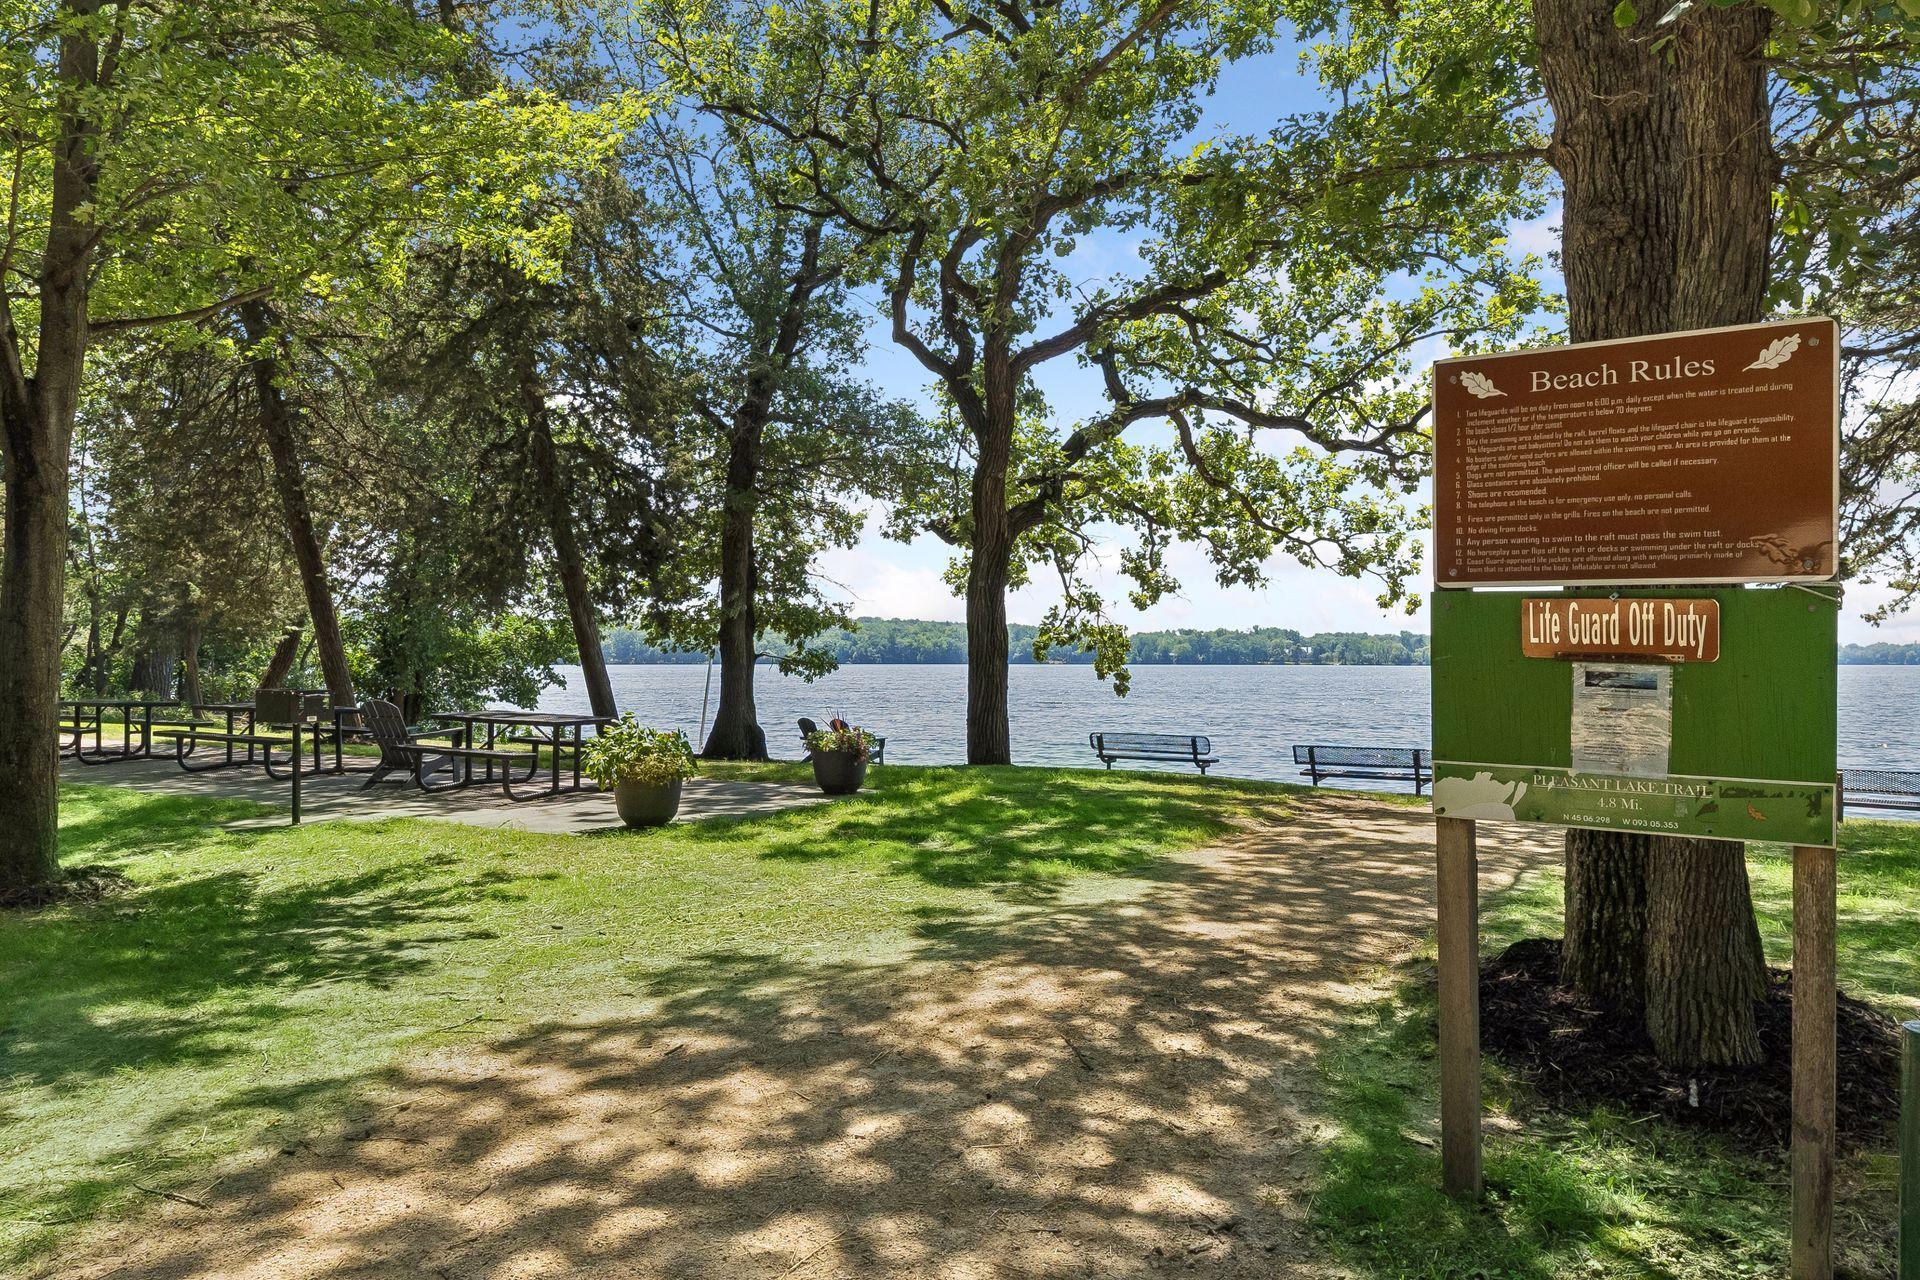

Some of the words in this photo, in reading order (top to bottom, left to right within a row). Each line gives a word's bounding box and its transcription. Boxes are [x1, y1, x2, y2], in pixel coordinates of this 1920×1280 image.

[1530, 364, 1619, 392] Beach
[1629, 356, 1716, 382] Rules
[1728, 385, 1754, 394] treated
[1548, 411, 1587, 420] temperature
[1626, 406, 1652, 414] degrees
[1651, 422, 1679, 431] lifeguard
[1718, 417, 1747, 426] lifeguard
[1528, 440, 1563, 450] babysitters!
[1570, 448, 1592, 456] allowed
[1710, 438, 1739, 447] provided
[1467, 472, 1482, 480] Dogs
[1578, 464, 1602, 473] control
[1485, 479, 1519, 487] containers
[1478, 500, 1508, 508] telephone
[1567, 496, 1602, 504] emergency
[1644, 491, 1674, 500] personal
[1510, 536, 1540, 544] wanting
[1477, 548, 1510, 556] horseplay
[1529, 602, 1560, 644] Life
[1568, 602, 1619, 646] Guard
[1629, 601, 1654, 646] Off
[1664, 604, 1706, 657] Duty
[1533, 775, 1612, 789] PLEASANT
[1616, 781, 1659, 793] LAKE
[1662, 783, 1709, 796] TRAIL
[1598, 798, 1617, 808] 4.8
[1621, 799, 1642, 810] Mi.
